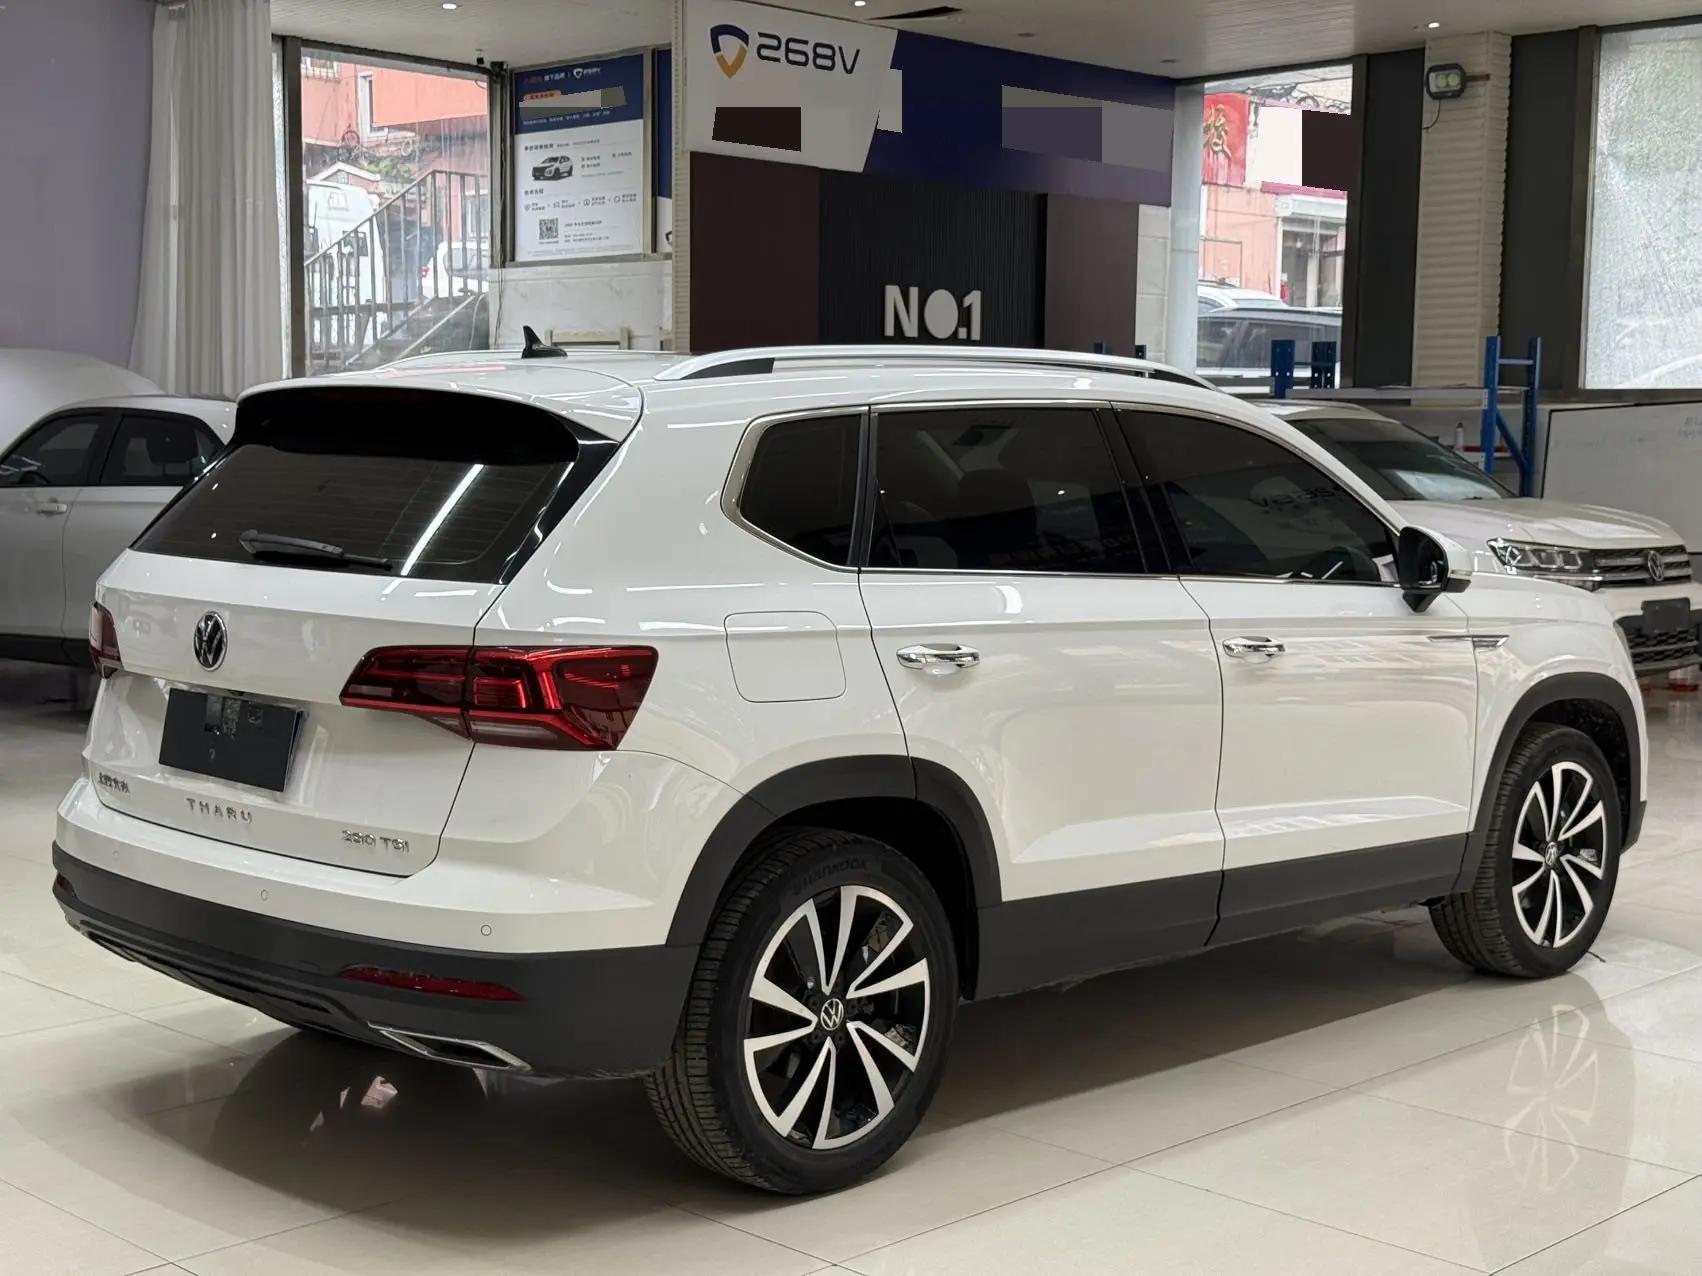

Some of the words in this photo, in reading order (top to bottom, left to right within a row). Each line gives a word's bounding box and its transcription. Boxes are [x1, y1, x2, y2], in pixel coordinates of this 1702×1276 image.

[756, 31, 861, 75] 268V
[884, 284, 982, 341] NO.1
[186, 798, 253, 824] THARU
[379, 836, 410, 853] TSI
